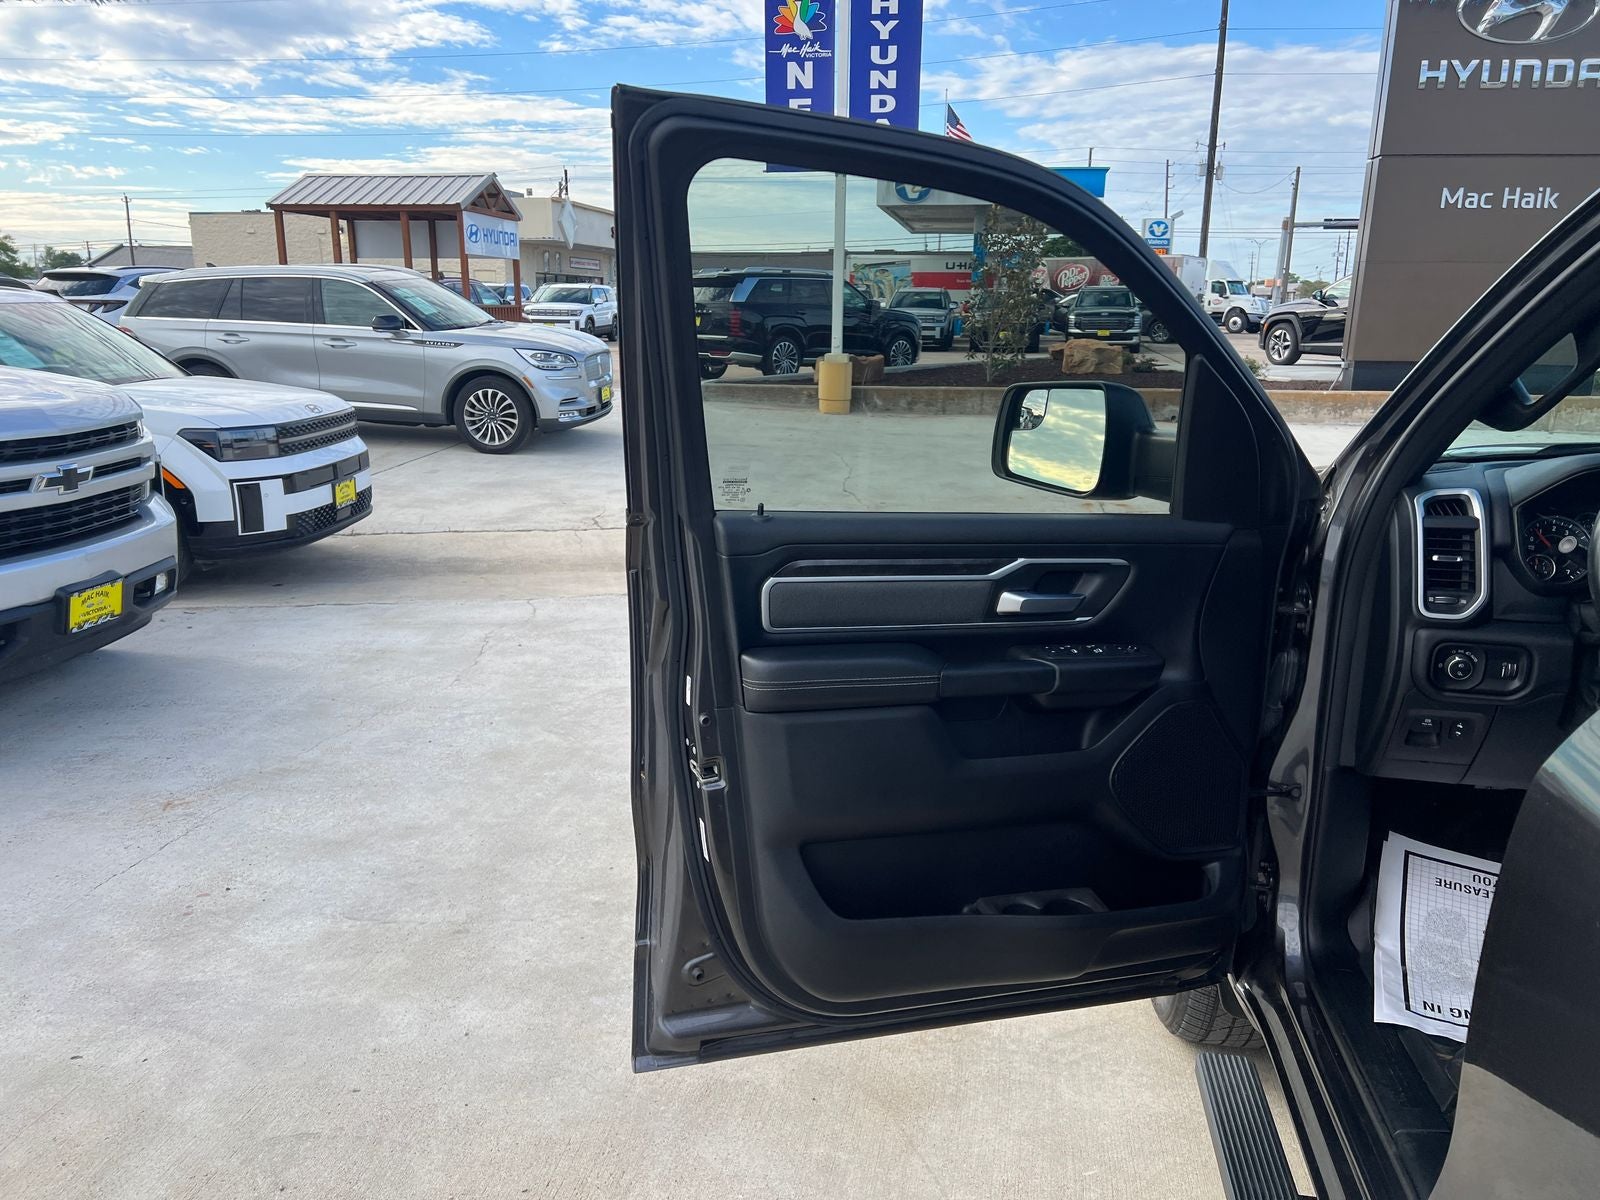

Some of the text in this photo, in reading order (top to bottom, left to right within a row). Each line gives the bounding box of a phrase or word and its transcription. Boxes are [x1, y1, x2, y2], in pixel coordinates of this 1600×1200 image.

[800, 41, 821, 57] Haik
[1440, 187, 1560, 209] Mac Haik
[482, 228, 518, 247] HYUNDAI
[1060, 270, 1087, 288] Pepper
[1068, 267, 1081, 278] Dr
[1434, 876, 1495, 899] EASURE
[1423, 1000, 1442, 1014] IN
